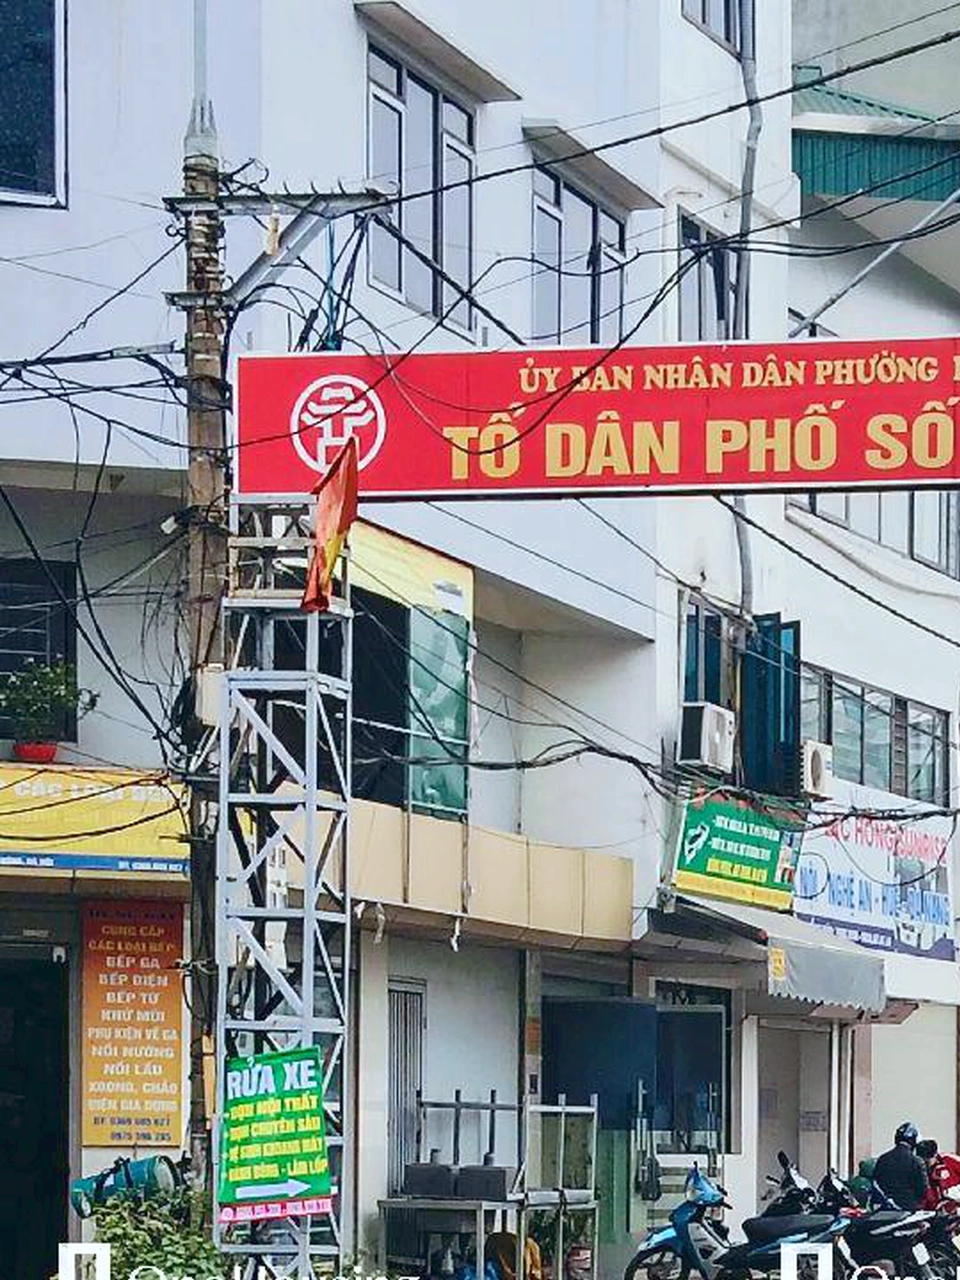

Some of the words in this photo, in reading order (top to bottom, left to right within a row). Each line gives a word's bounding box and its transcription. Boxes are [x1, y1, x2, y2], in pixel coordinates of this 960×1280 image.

[519, 358, 561, 393] ỦY
[644, 355, 731, 389] NHÂN
[742, 353, 806, 388] DÂN
[815, 350, 939, 385] PHƯỜNG
[545, 410, 680, 478] DÂN
[705, 399, 846, 474] PHỐ
[227, 1056, 276, 1100] RỬA
[283, 1059, 317, 1090] XE
